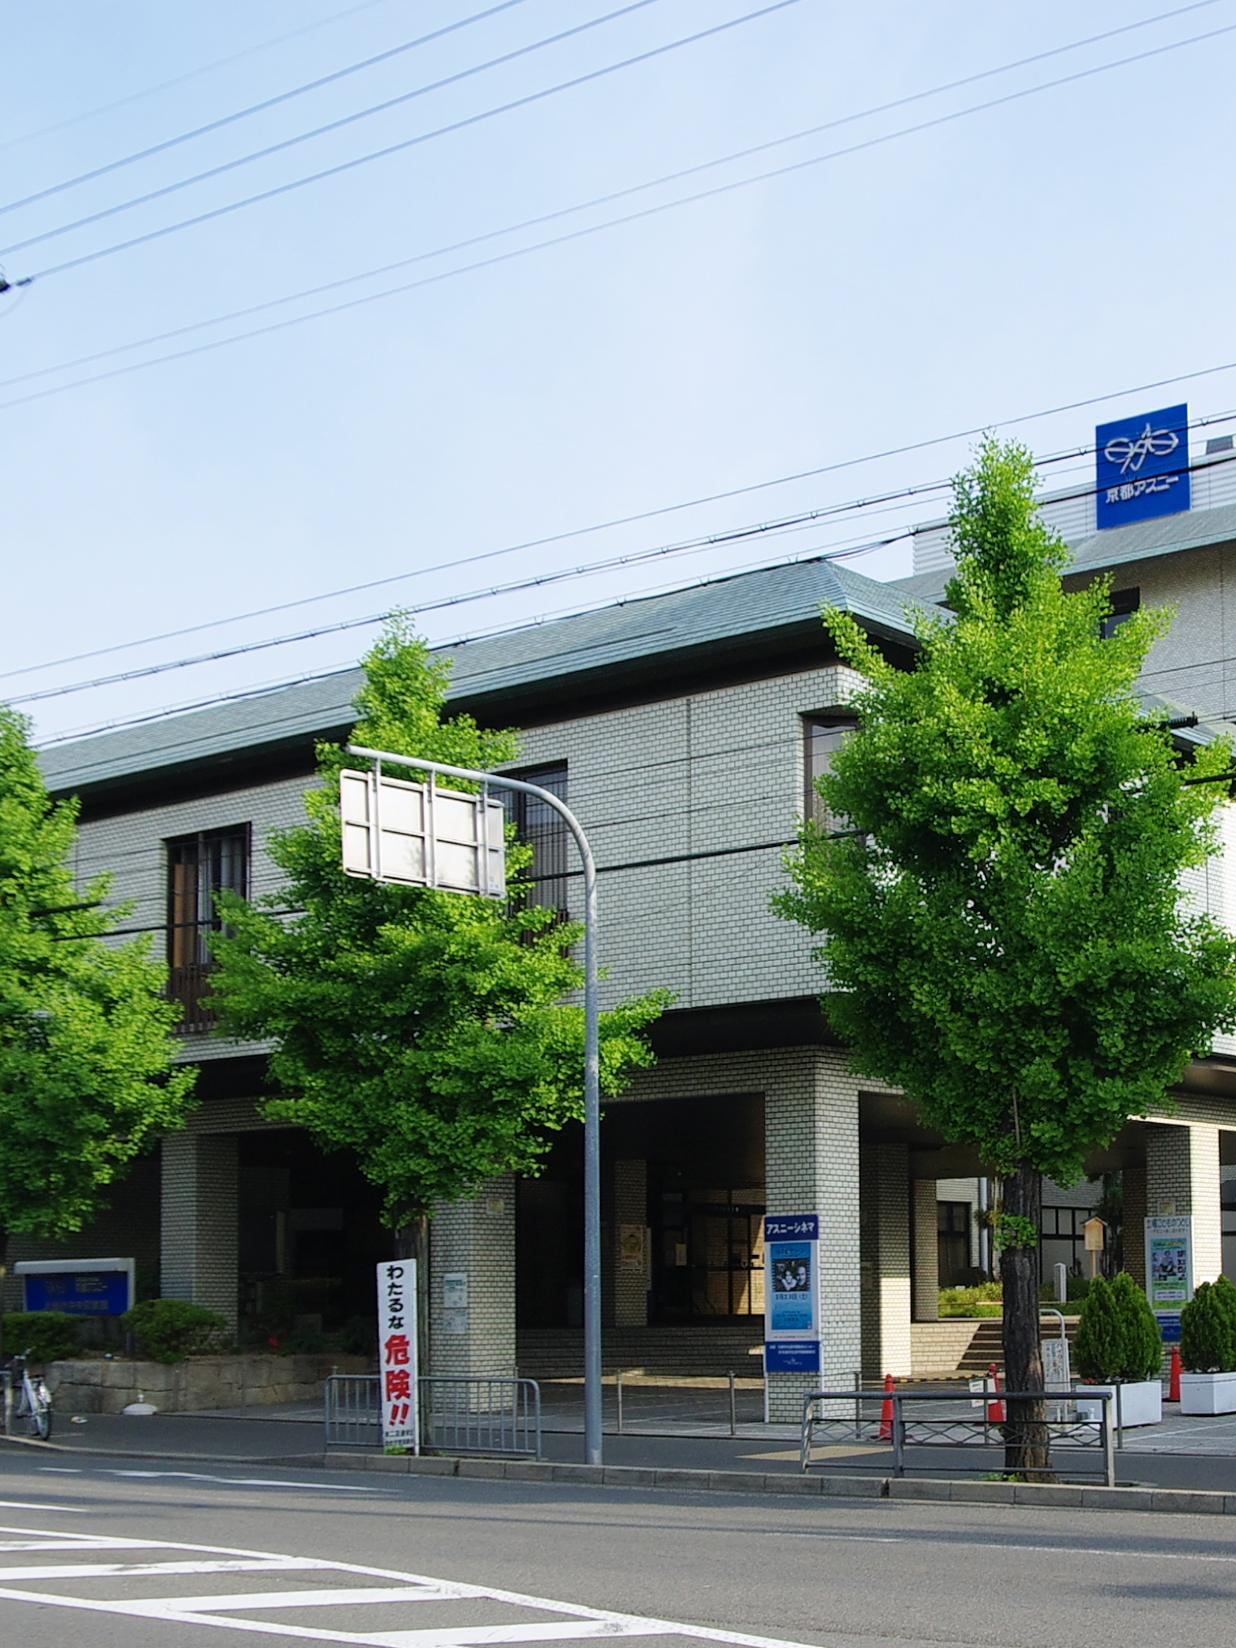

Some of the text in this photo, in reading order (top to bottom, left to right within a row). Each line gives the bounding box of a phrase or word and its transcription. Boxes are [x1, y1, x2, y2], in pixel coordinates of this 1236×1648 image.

[1105, 476, 1179, 504] 京都アスニー
[766, 1222, 815, 1236] アスニーシネマ
